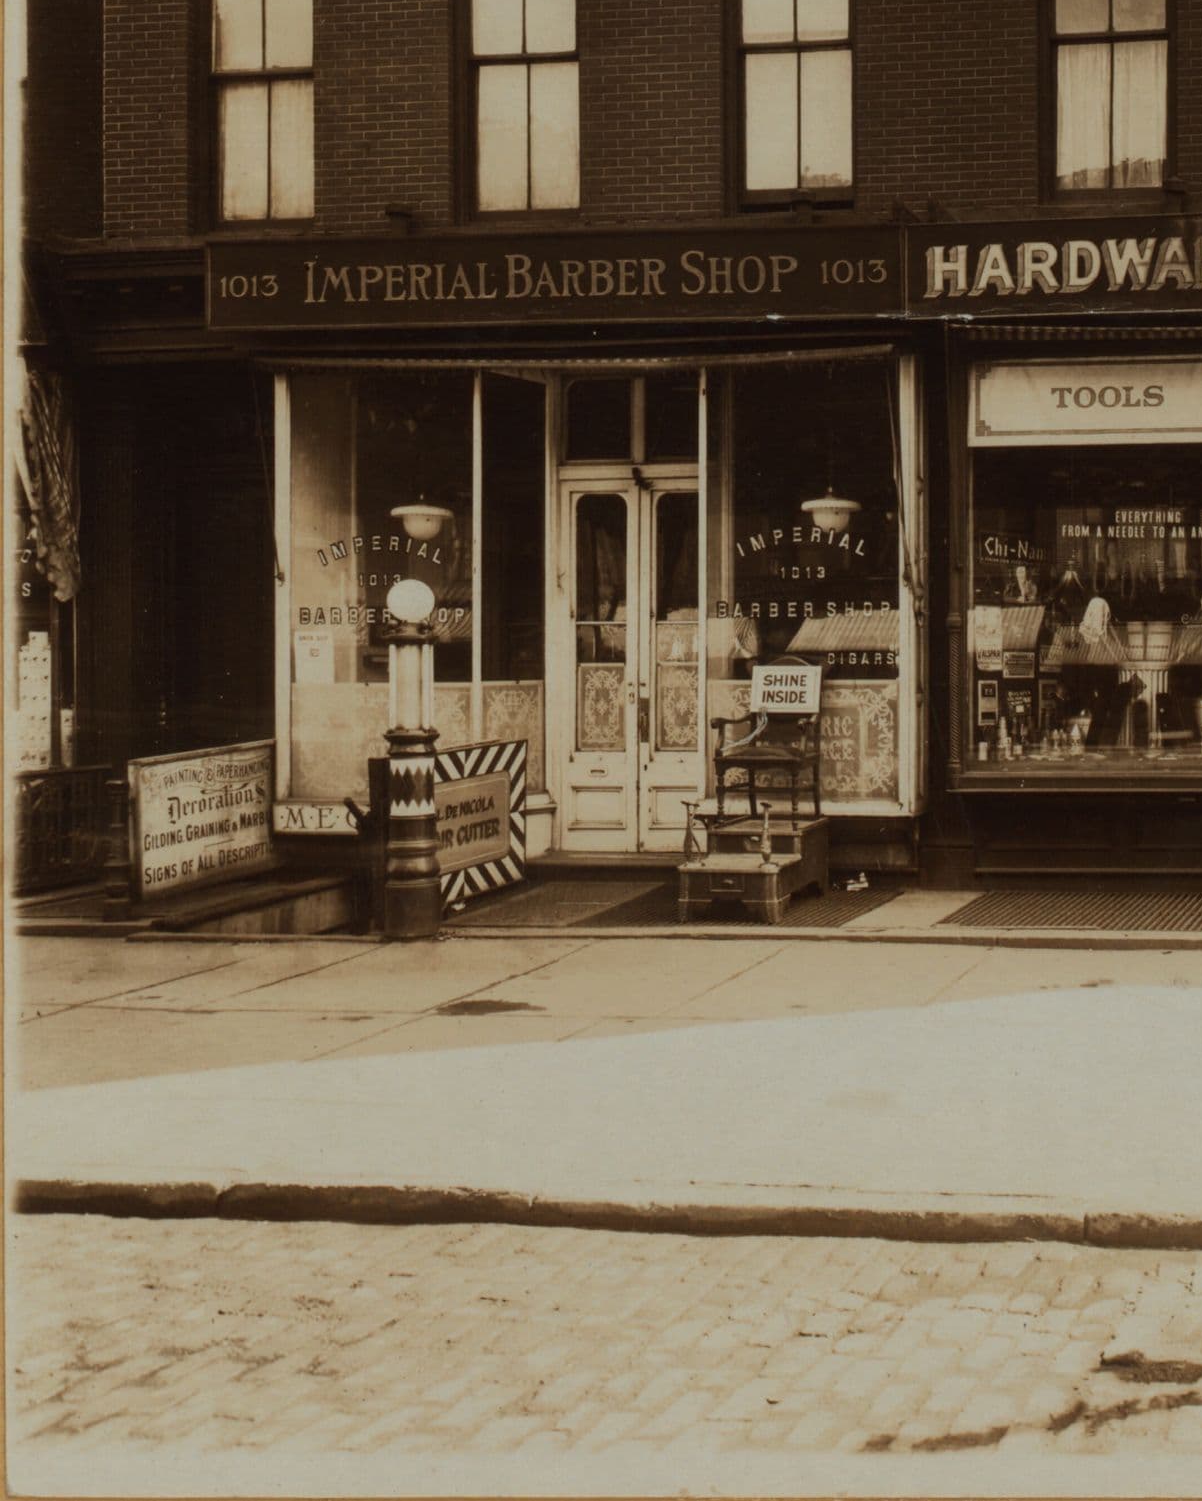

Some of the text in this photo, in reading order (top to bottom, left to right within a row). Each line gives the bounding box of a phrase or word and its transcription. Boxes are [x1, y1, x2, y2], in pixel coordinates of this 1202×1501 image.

[219, 250, 889, 303] 1013 IMPERIAL BARBER SHOP 1013
[1050, 385, 1166, 409] TOOLS
[1115, 509, 1184, 523] EVERYTHING
[1061, 525, 1090, 537] FROM
[1096, 526, 1103, 538] A
[1107, 526, 1145, 538] NEEDLE
[1152, 526, 1166, 538] TO
[1171, 526, 1185, 538] AN
[736, 526, 865, 557] IMPERIAL
[317, 535, 442, 567] IMPERIAL
[359, 573, 401, 587] 1013
[780, 566, 827, 579] 1013
[299, 606, 391, 625] BARBER
[716, 601, 892, 619] BARBER SHOP
[827, 652, 895, 666] CIGARS
[762, 674, 808, 687] SHINE
[761, 690, 808, 704] INSIDE
[185, 818, 231, 842] GRAINING
[456, 818, 500, 847] CUTTER
[144, 863, 178, 885] SIGNS
[181, 859, 194, 875] OF
[197, 854, 216, 873] ALL
